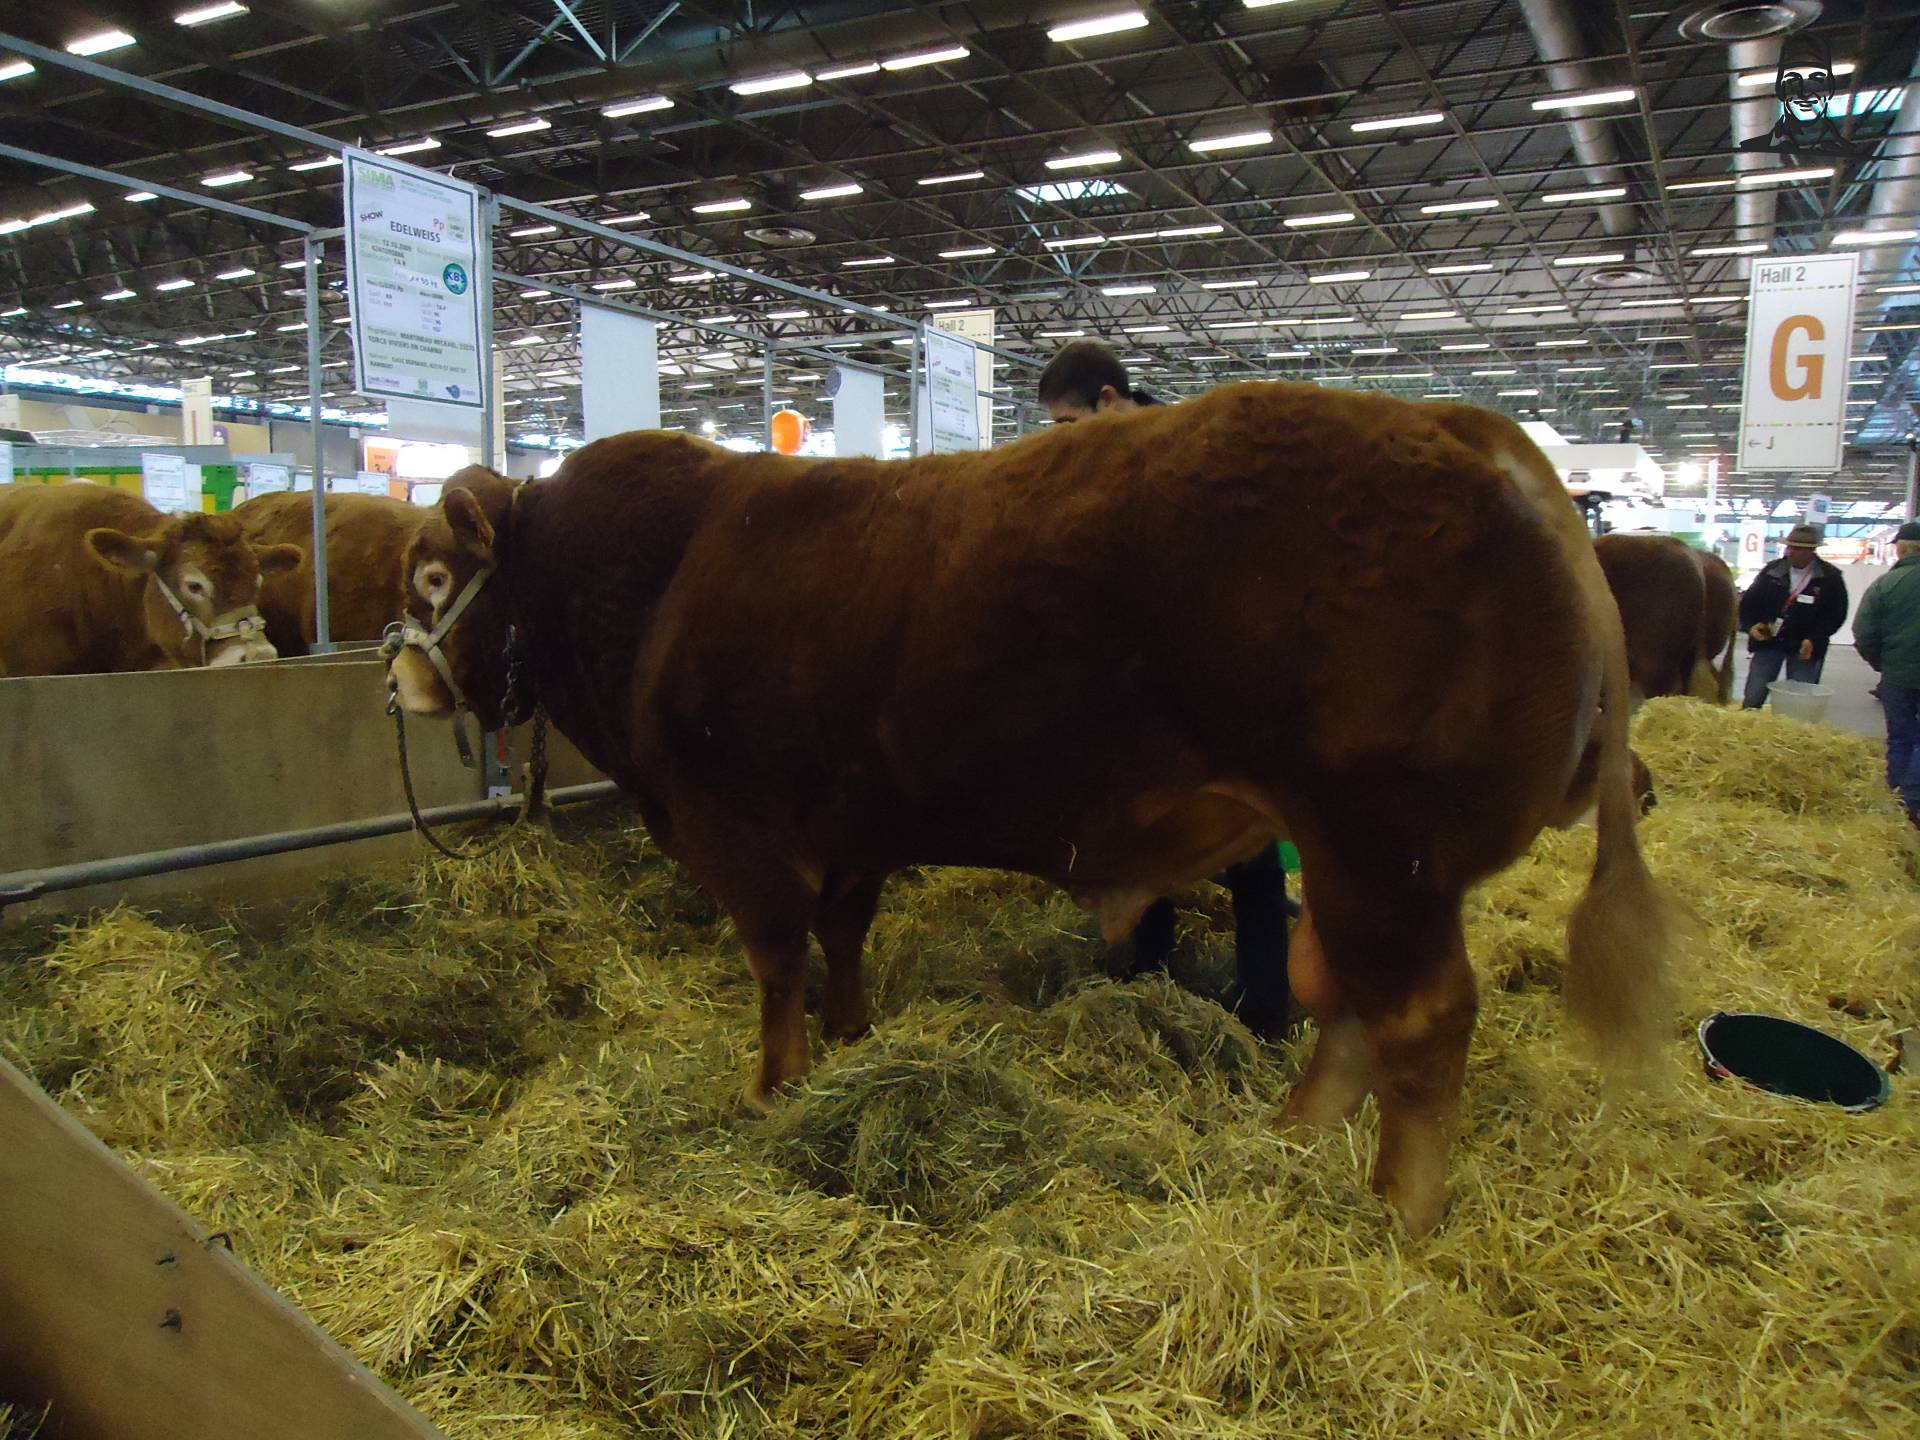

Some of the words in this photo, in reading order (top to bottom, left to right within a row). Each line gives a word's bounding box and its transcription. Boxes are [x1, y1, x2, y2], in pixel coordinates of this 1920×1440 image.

[360, 210, 383, 222] SHOW
[390, 221, 441, 243] EDELWEISS
[1761, 267, 1791, 283] Hall
[1795, 266, 1806, 282] 2
[938, 319, 956, 332] Hall
[957, 319, 965, 332] 2
[1769, 314, 1825, 402] G
[1765, 436, 1775, 450] J
[1745, 532, 1759, 553] G
